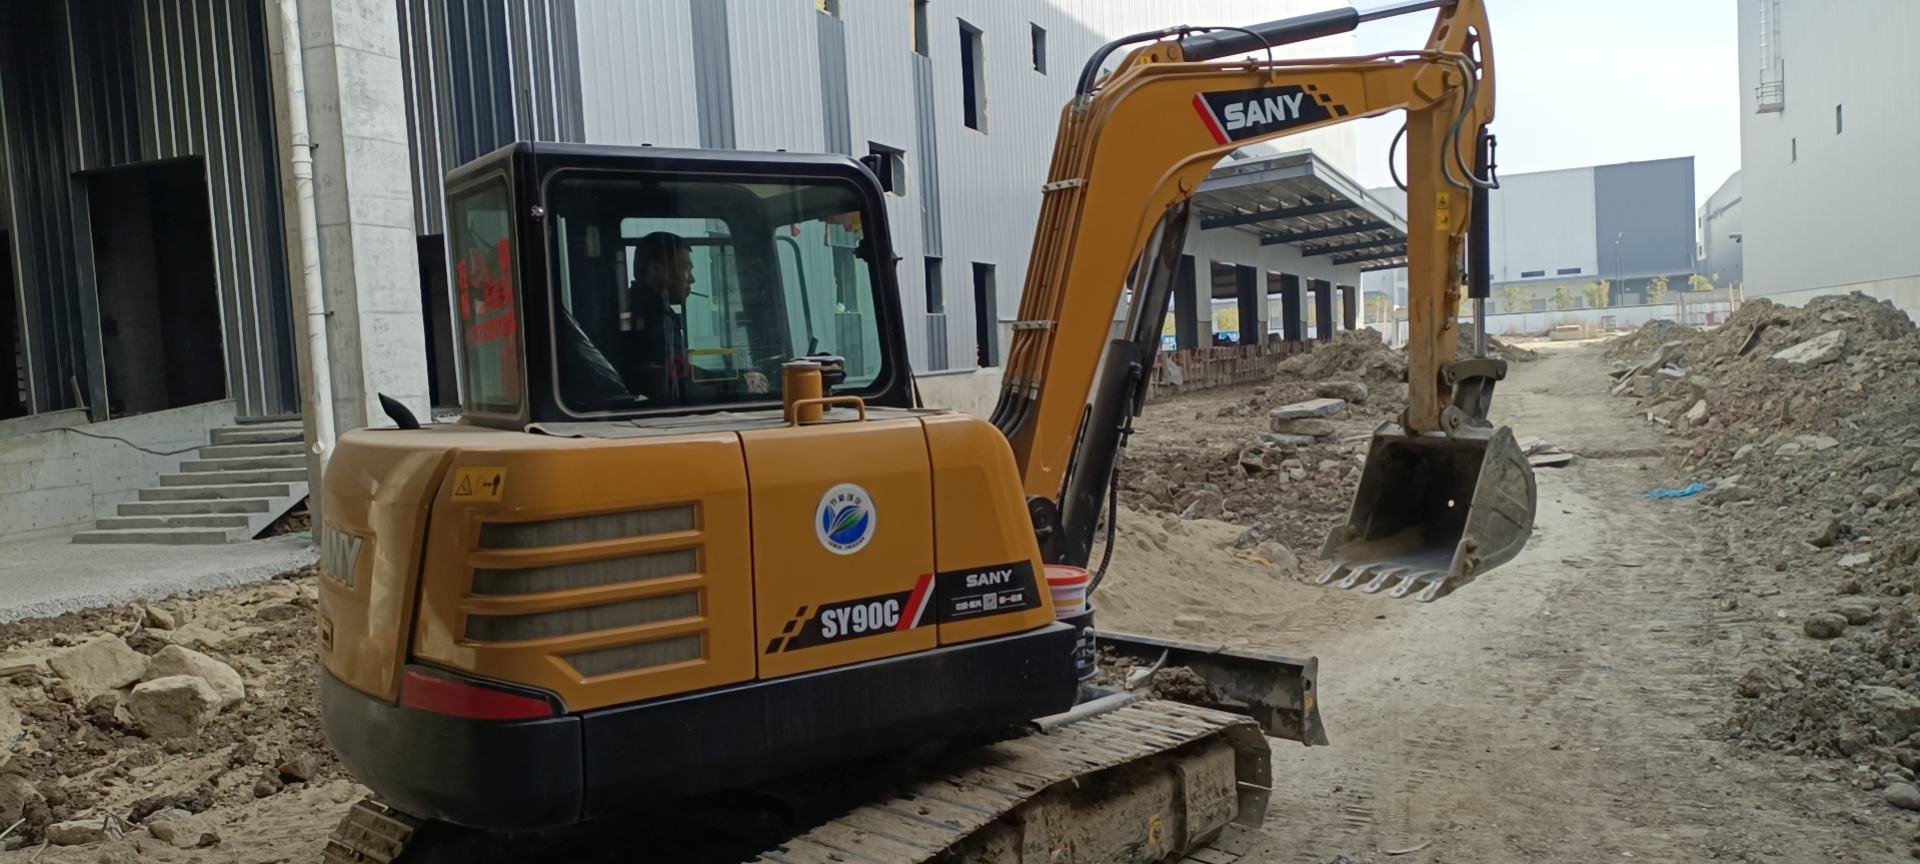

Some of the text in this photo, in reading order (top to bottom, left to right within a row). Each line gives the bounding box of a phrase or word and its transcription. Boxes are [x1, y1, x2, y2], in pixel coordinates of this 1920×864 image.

[1224, 92, 1304, 130] SANY
[965, 569, 1013, 588] SANY
[821, 598, 900, 639] SY90C
